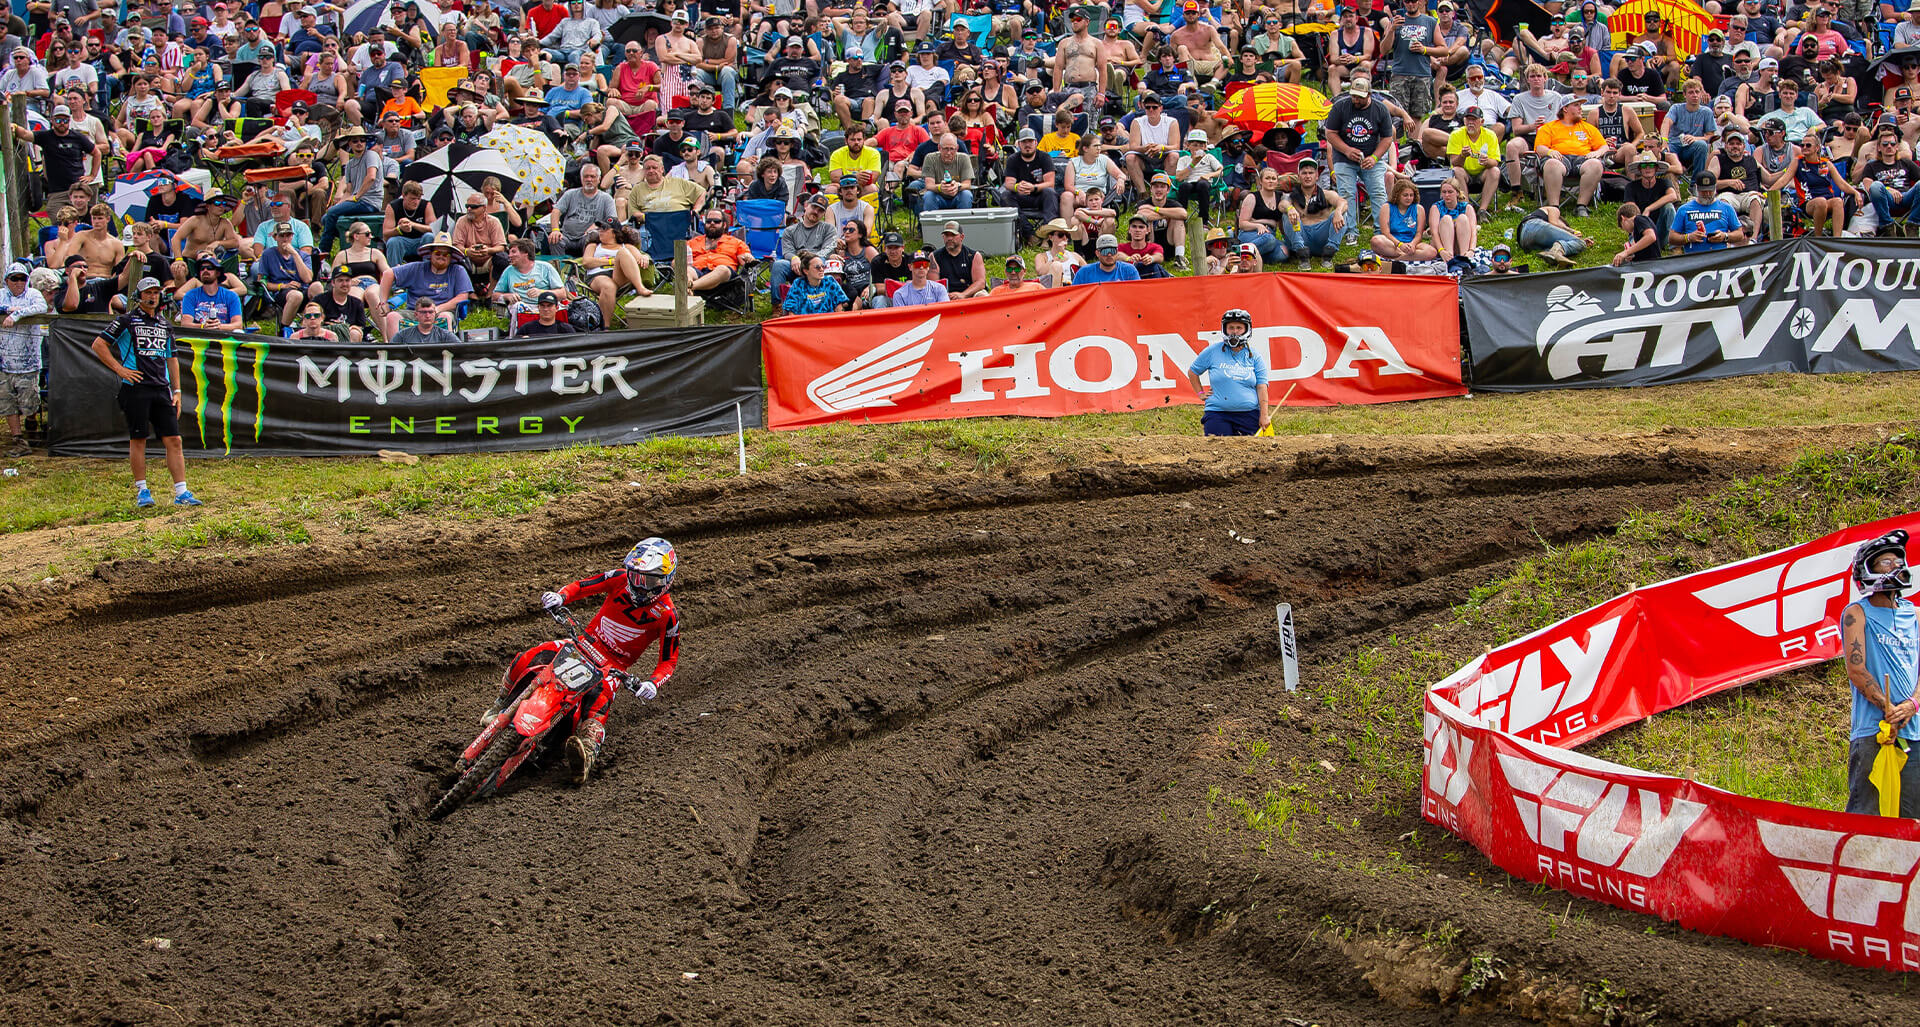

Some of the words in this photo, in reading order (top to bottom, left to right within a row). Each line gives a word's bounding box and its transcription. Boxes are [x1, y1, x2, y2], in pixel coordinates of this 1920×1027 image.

[1689, 212, 1720, 220] YAMAHA
[1614, 262, 1778, 312] ROCKY
[137, 337, 167, 349] FXR
[948, 326, 1424, 403] HONDA
[1547, 299, 1797, 380] ATV
[296, 350, 639, 405] MONSTER
[350, 416, 585, 434] ENERGY
[1282, 626, 1293, 659] UFO
[553, 657, 594, 688] 10
[1458, 615, 1621, 735] FLY
[1421, 795, 1460, 832] CING
[1496, 752, 1709, 878] FLY
[1538, 854, 1646, 907] RACING
